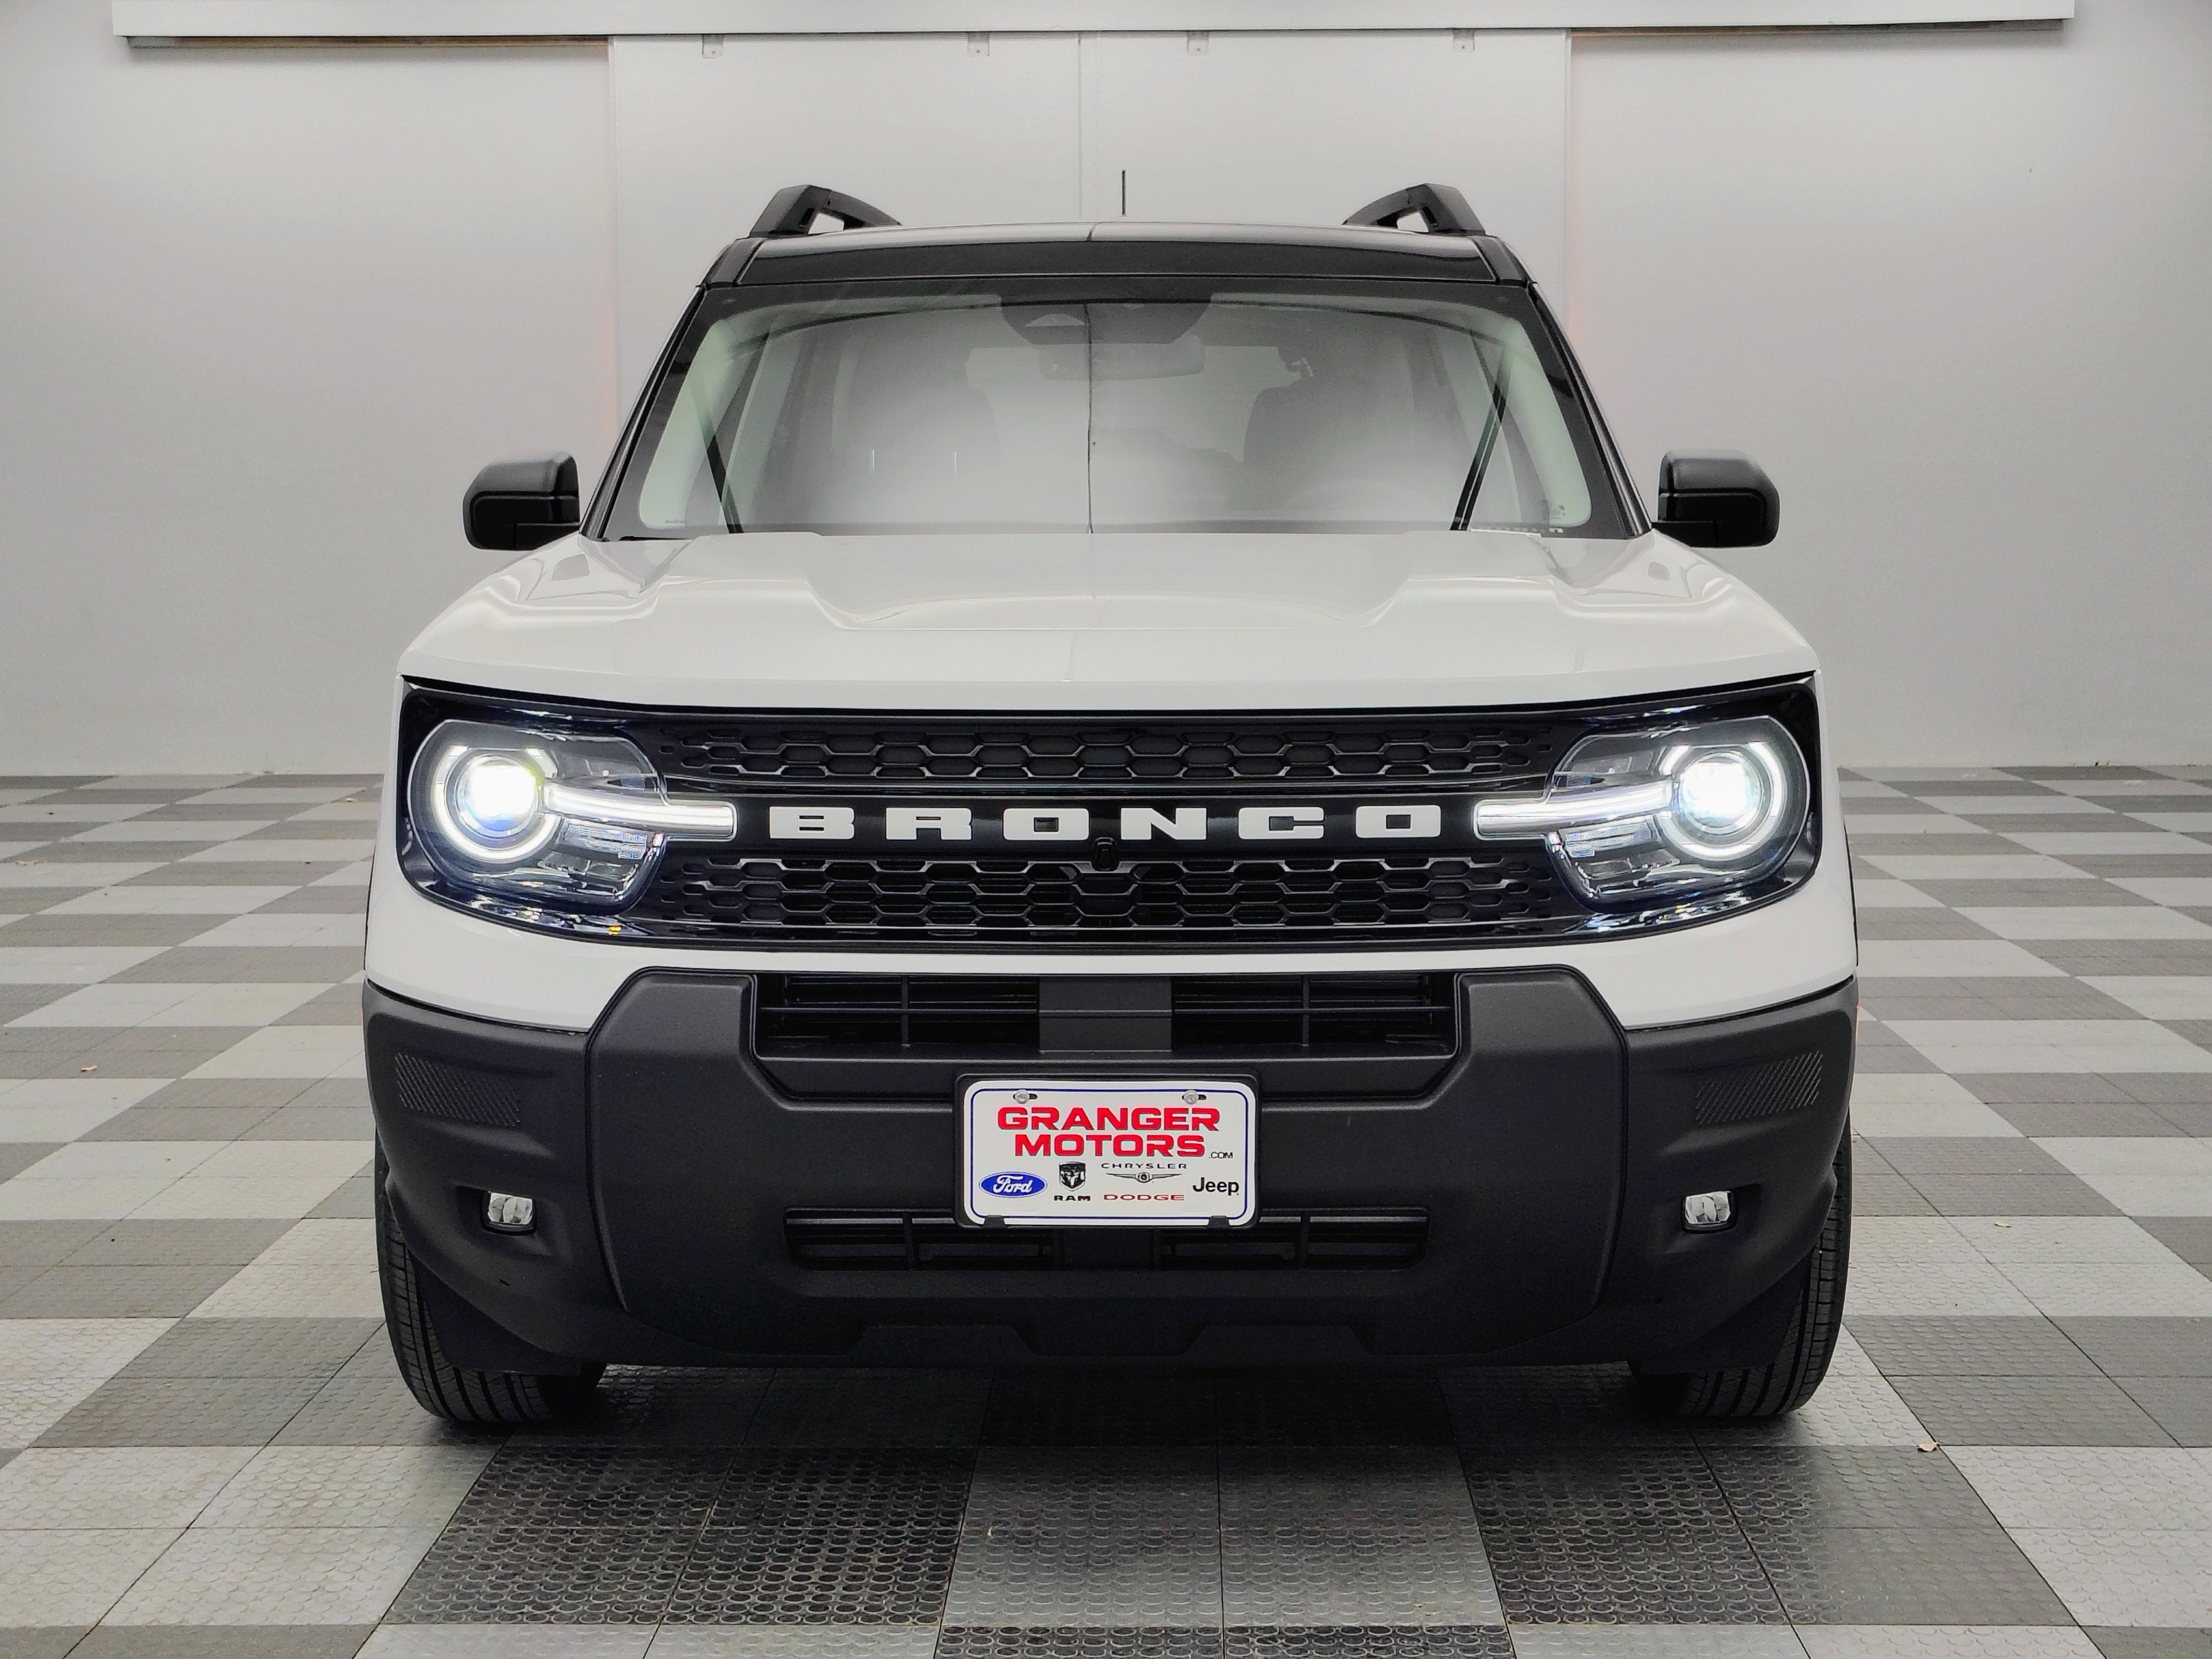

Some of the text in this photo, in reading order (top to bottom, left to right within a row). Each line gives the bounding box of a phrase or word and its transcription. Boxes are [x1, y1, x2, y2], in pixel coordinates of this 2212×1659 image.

[770, 805, 1441, 841] BRONCO
[997, 1107, 1220, 1131] GRANGER
[1015, 1135, 1205, 1157] MOTORS
[993, 1172, 1033, 1193] Ford
[1192, 1177, 1239, 1196] Jeep
